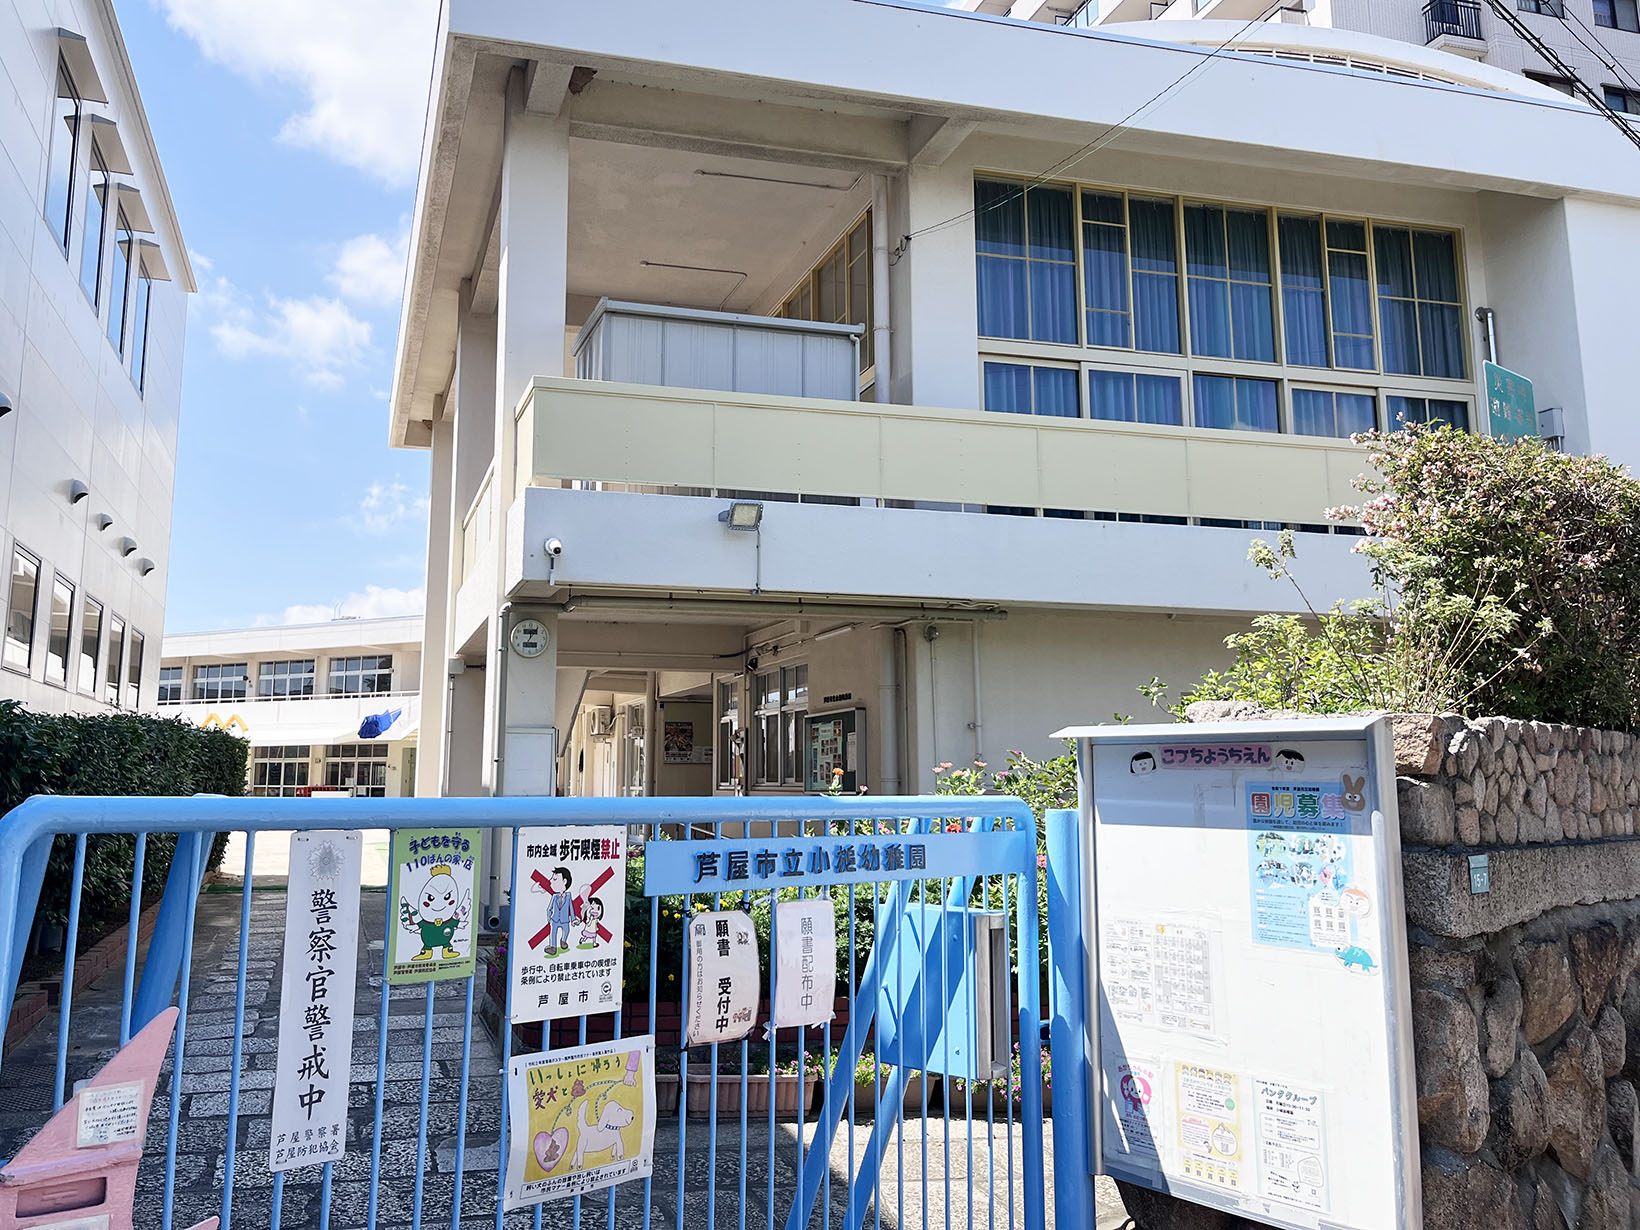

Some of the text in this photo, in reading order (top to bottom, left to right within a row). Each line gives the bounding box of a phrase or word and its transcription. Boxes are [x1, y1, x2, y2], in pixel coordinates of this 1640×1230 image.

[1251, 792, 1345, 819] 園児募集
[409, 835, 470, 854] 子どもを守る
[526, 838, 620, 861] 市内全域 歩行喫煙禁止
[694, 843, 927, 884] 芦屋市立小槌幼稚園
[1473, 872, 1487, 888] 15-7
[800, 916, 814, 1011] 願書配布中
[520, 968, 612, 986] 条例により禁止されています
[715, 919, 732, 1034] 願書 受付中
[297, 889, 338, 1121] 警察官警戒中
[537, 990, 589, 1008] 芦屋市
[533, 1085, 568, 1110] 愛犬と
[276, 1123, 340, 1146] 芦屋警察署
[275, 1139, 339, 1161] 芦屋防犯協会
